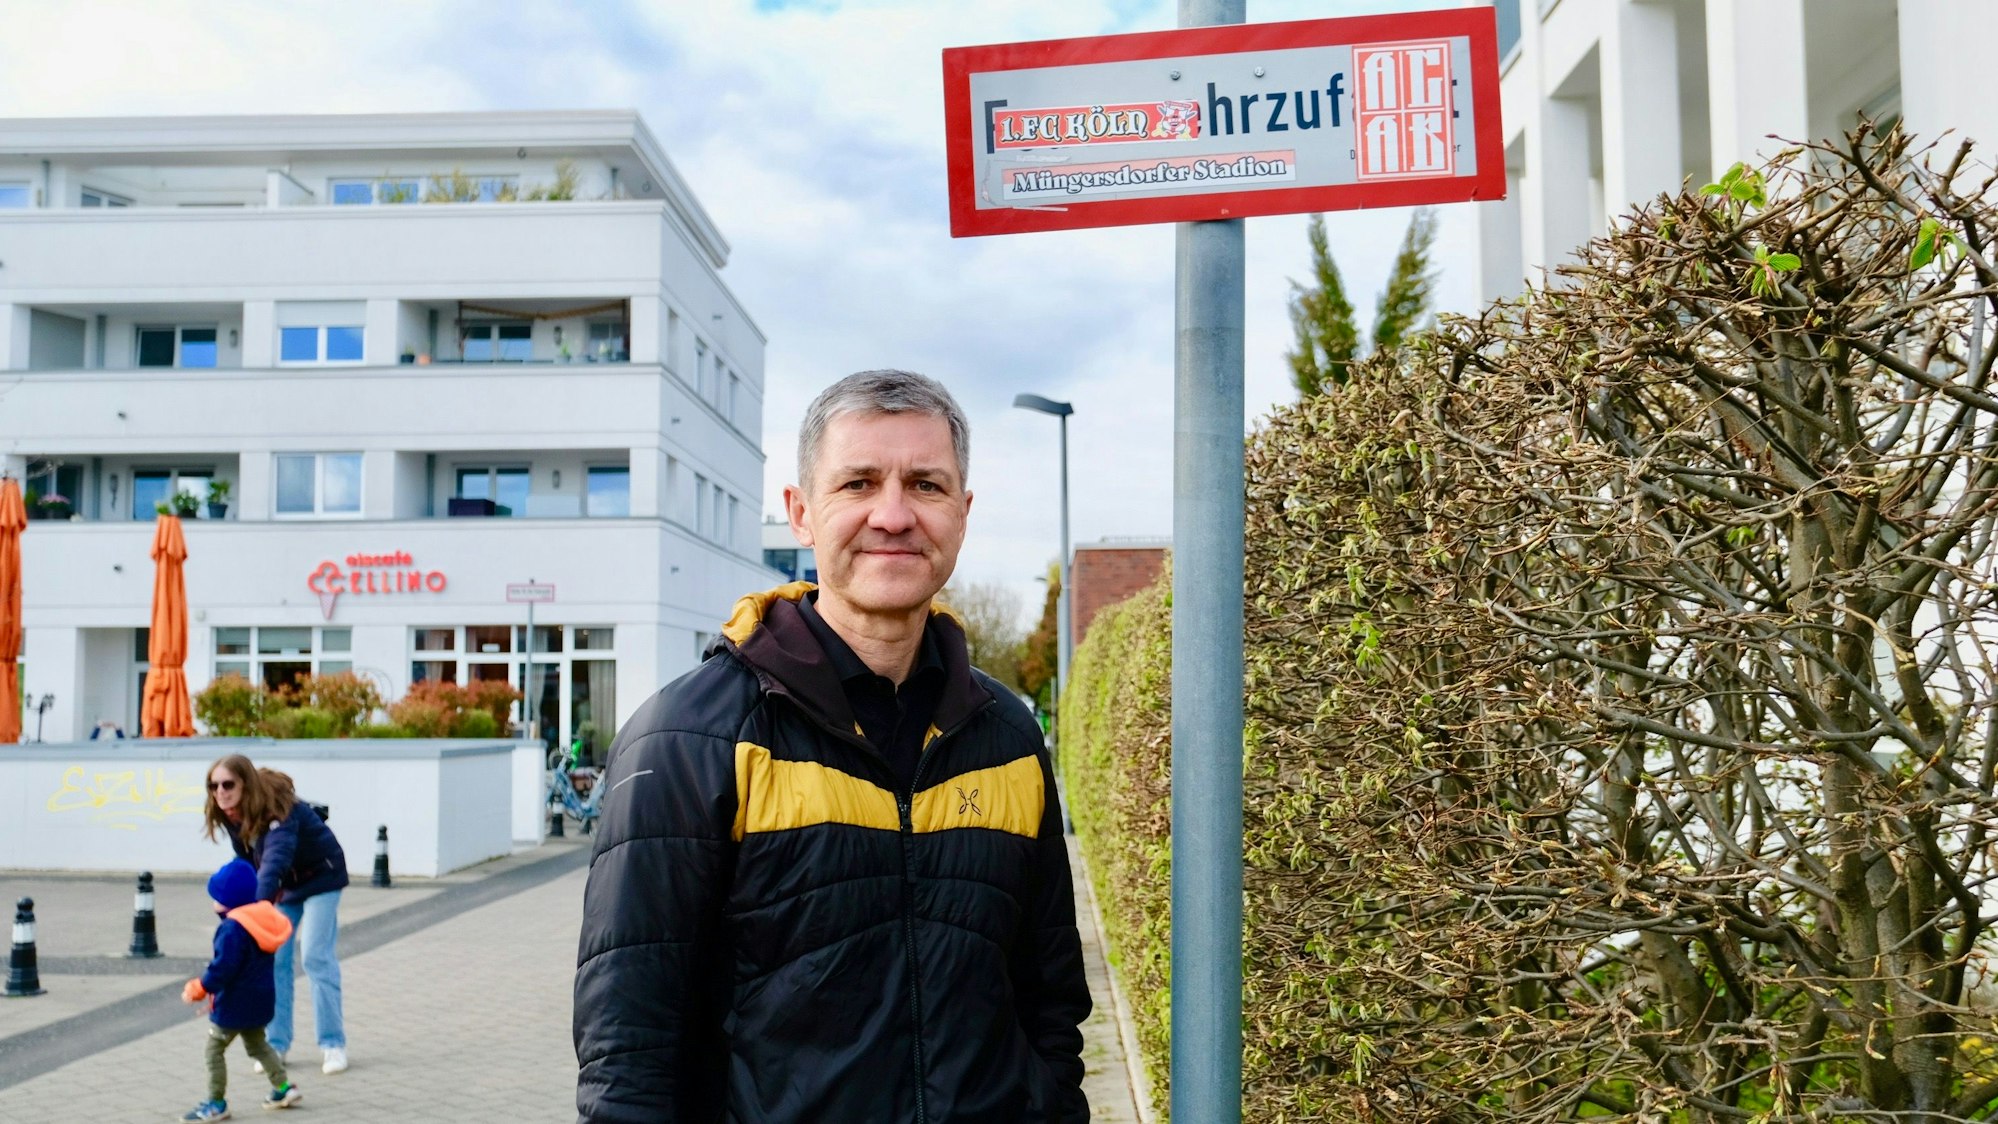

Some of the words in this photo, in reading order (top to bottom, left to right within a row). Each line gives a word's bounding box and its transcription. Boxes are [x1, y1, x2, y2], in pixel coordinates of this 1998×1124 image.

[1001, 114, 1062, 142] 1.FC
[1065, 106, 1149, 142] KÖLN
[1012, 161, 1190, 194] Müngersdorfer
[1193, 156, 1287, 180] Stadion
